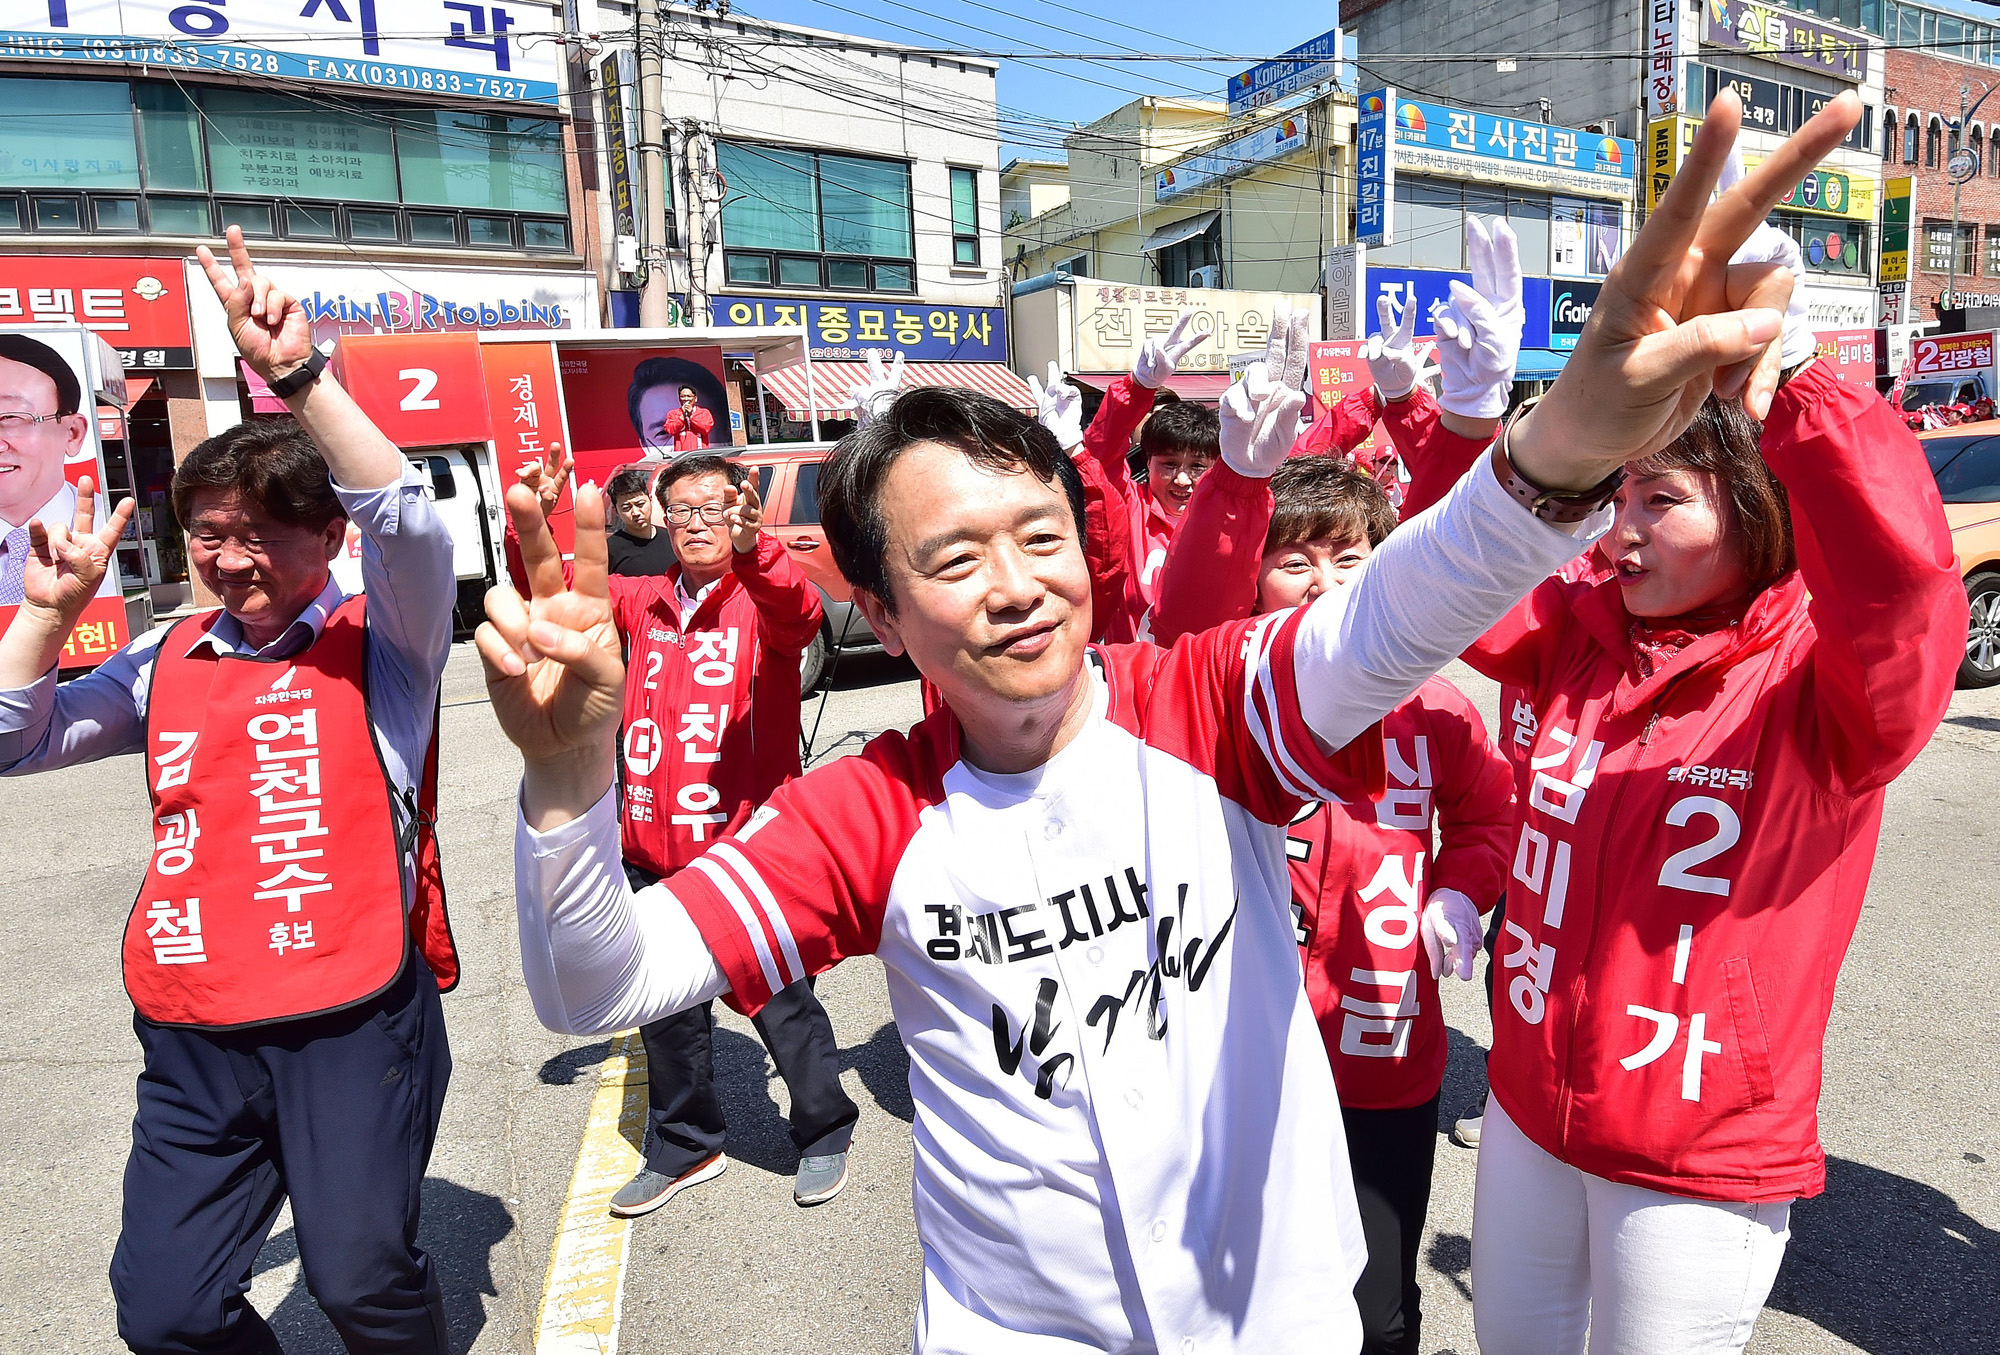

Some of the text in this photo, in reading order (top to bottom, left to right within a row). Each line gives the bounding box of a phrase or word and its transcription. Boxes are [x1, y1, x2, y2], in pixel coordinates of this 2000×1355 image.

[1737, 10, 1858, 68] 스타 만들기
[240, 148, 362, 167] 치주치료 소아치과
[1655, 127, 1669, 168] MEGA
[240, 162, 364, 180] 부분교정 예방치료
[242, 175, 300, 188] 구강외과
[1881, 283, 1905, 293] 대한
[824, 347, 893, 358] 832-206
[1838, 342, 1873, 365] 심미영
[1917, 341, 1939, 372] 2
[1939, 346, 1991, 370] 김광철
[398, 368, 440, 411] 2
[254, 688, 313, 705] 자유한국당
[671, 626, 741, 843] 정친우
[246, 707, 334, 914] 연천군수
[145, 730, 208, 966] 김광철
[1503, 726, 1606, 1026] 김미경
[923, 866, 1151, 965] 경제도지사
[267, 919, 316, 956] 후보
